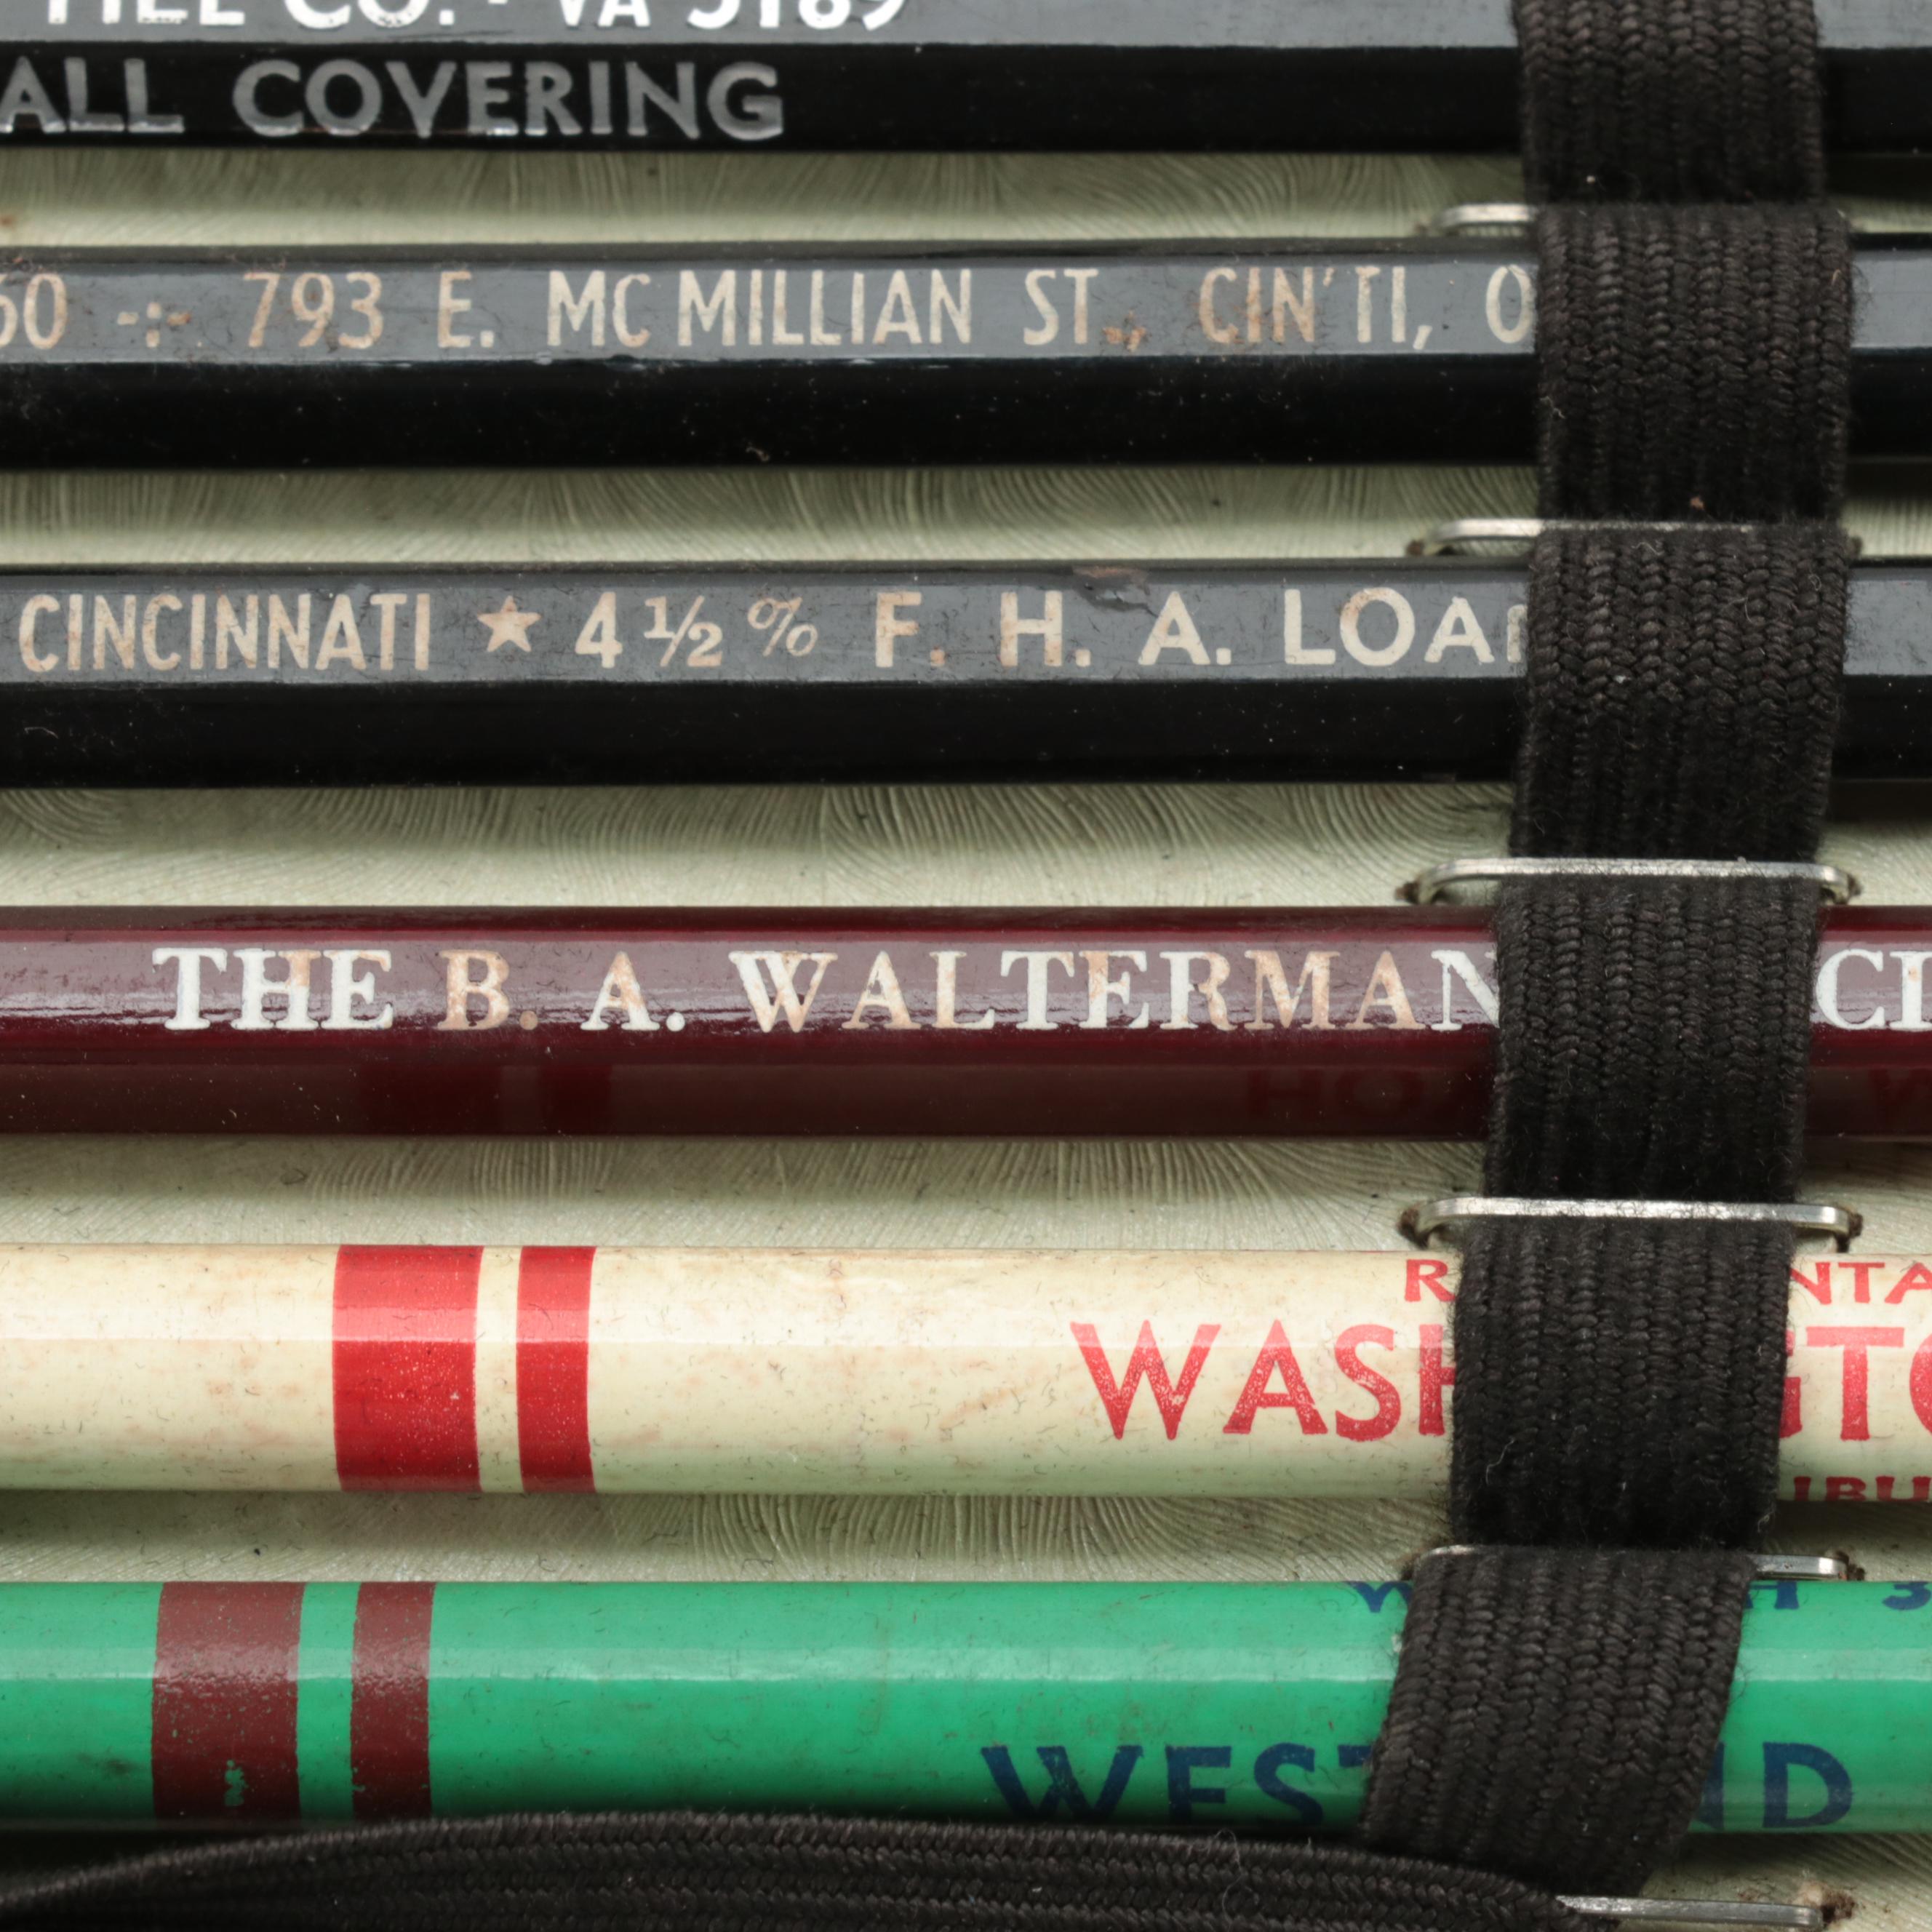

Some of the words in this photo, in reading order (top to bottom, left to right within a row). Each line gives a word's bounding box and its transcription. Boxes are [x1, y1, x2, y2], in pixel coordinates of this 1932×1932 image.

[233, 60, 784, 141] COVERING
[243, 272, 384, 350] 793
[438, 271, 495, 348] E.
[547, 270, 652, 348] MC
[677, 268, 973, 347] MILLIAN
[19, 594, 431, 673] CINCINNATI
[875, 591, 946, 668] F.
[1000, 591, 1092, 668] H.
[1138, 591, 1232, 666] A.
[152, 948, 394, 1031] THE
[438, 949, 538, 1031] B.
[580, 951, 686, 1031] A.
[728, 950, 1501, 1033] WALTERMAN
